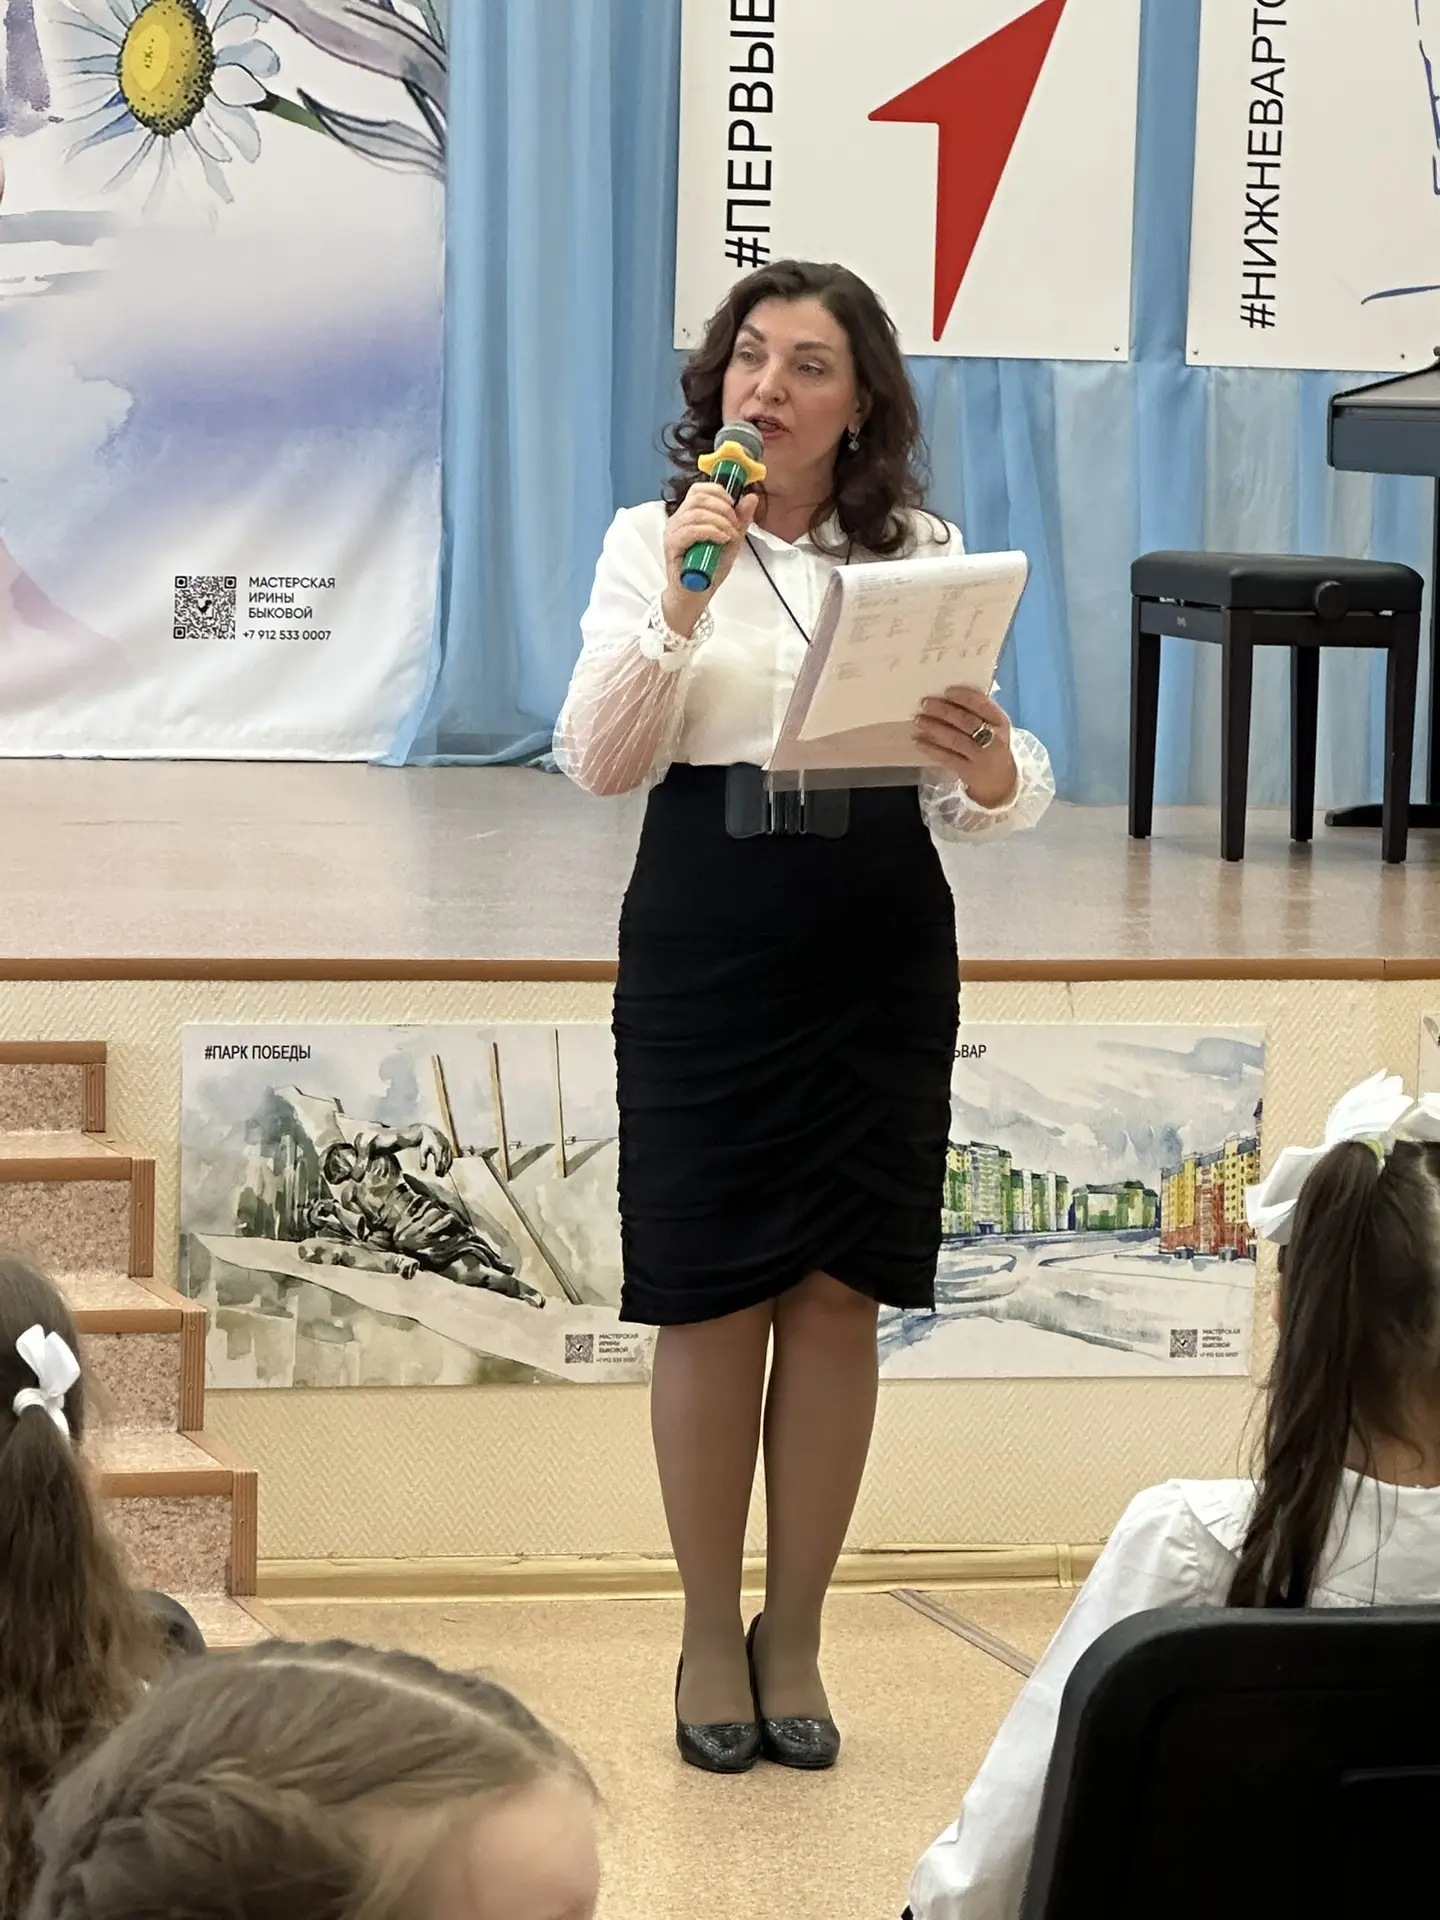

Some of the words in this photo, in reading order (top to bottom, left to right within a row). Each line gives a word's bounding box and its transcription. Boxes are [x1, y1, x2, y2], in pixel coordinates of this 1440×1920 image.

[725, 0, 775, 268] #ПЕРВЫЕ
[1240, 0, 1287, 328] #НИЖНЕВАРТ
[249, 576, 336, 589] МАСТЕРСКАЯ
[249, 592, 295, 604] ИРИНЫ
[248, 606, 313, 619] БЫКОВОЙ
[243, 630, 255, 640] +7
[258, 630, 277, 640] 912
[279, 630, 300, 641] 533
[302, 630, 331, 641] 0007
[204, 1045, 248, 1060] #ПАРК
[252, 1045, 311, 1062] ПОБЕДЫ
